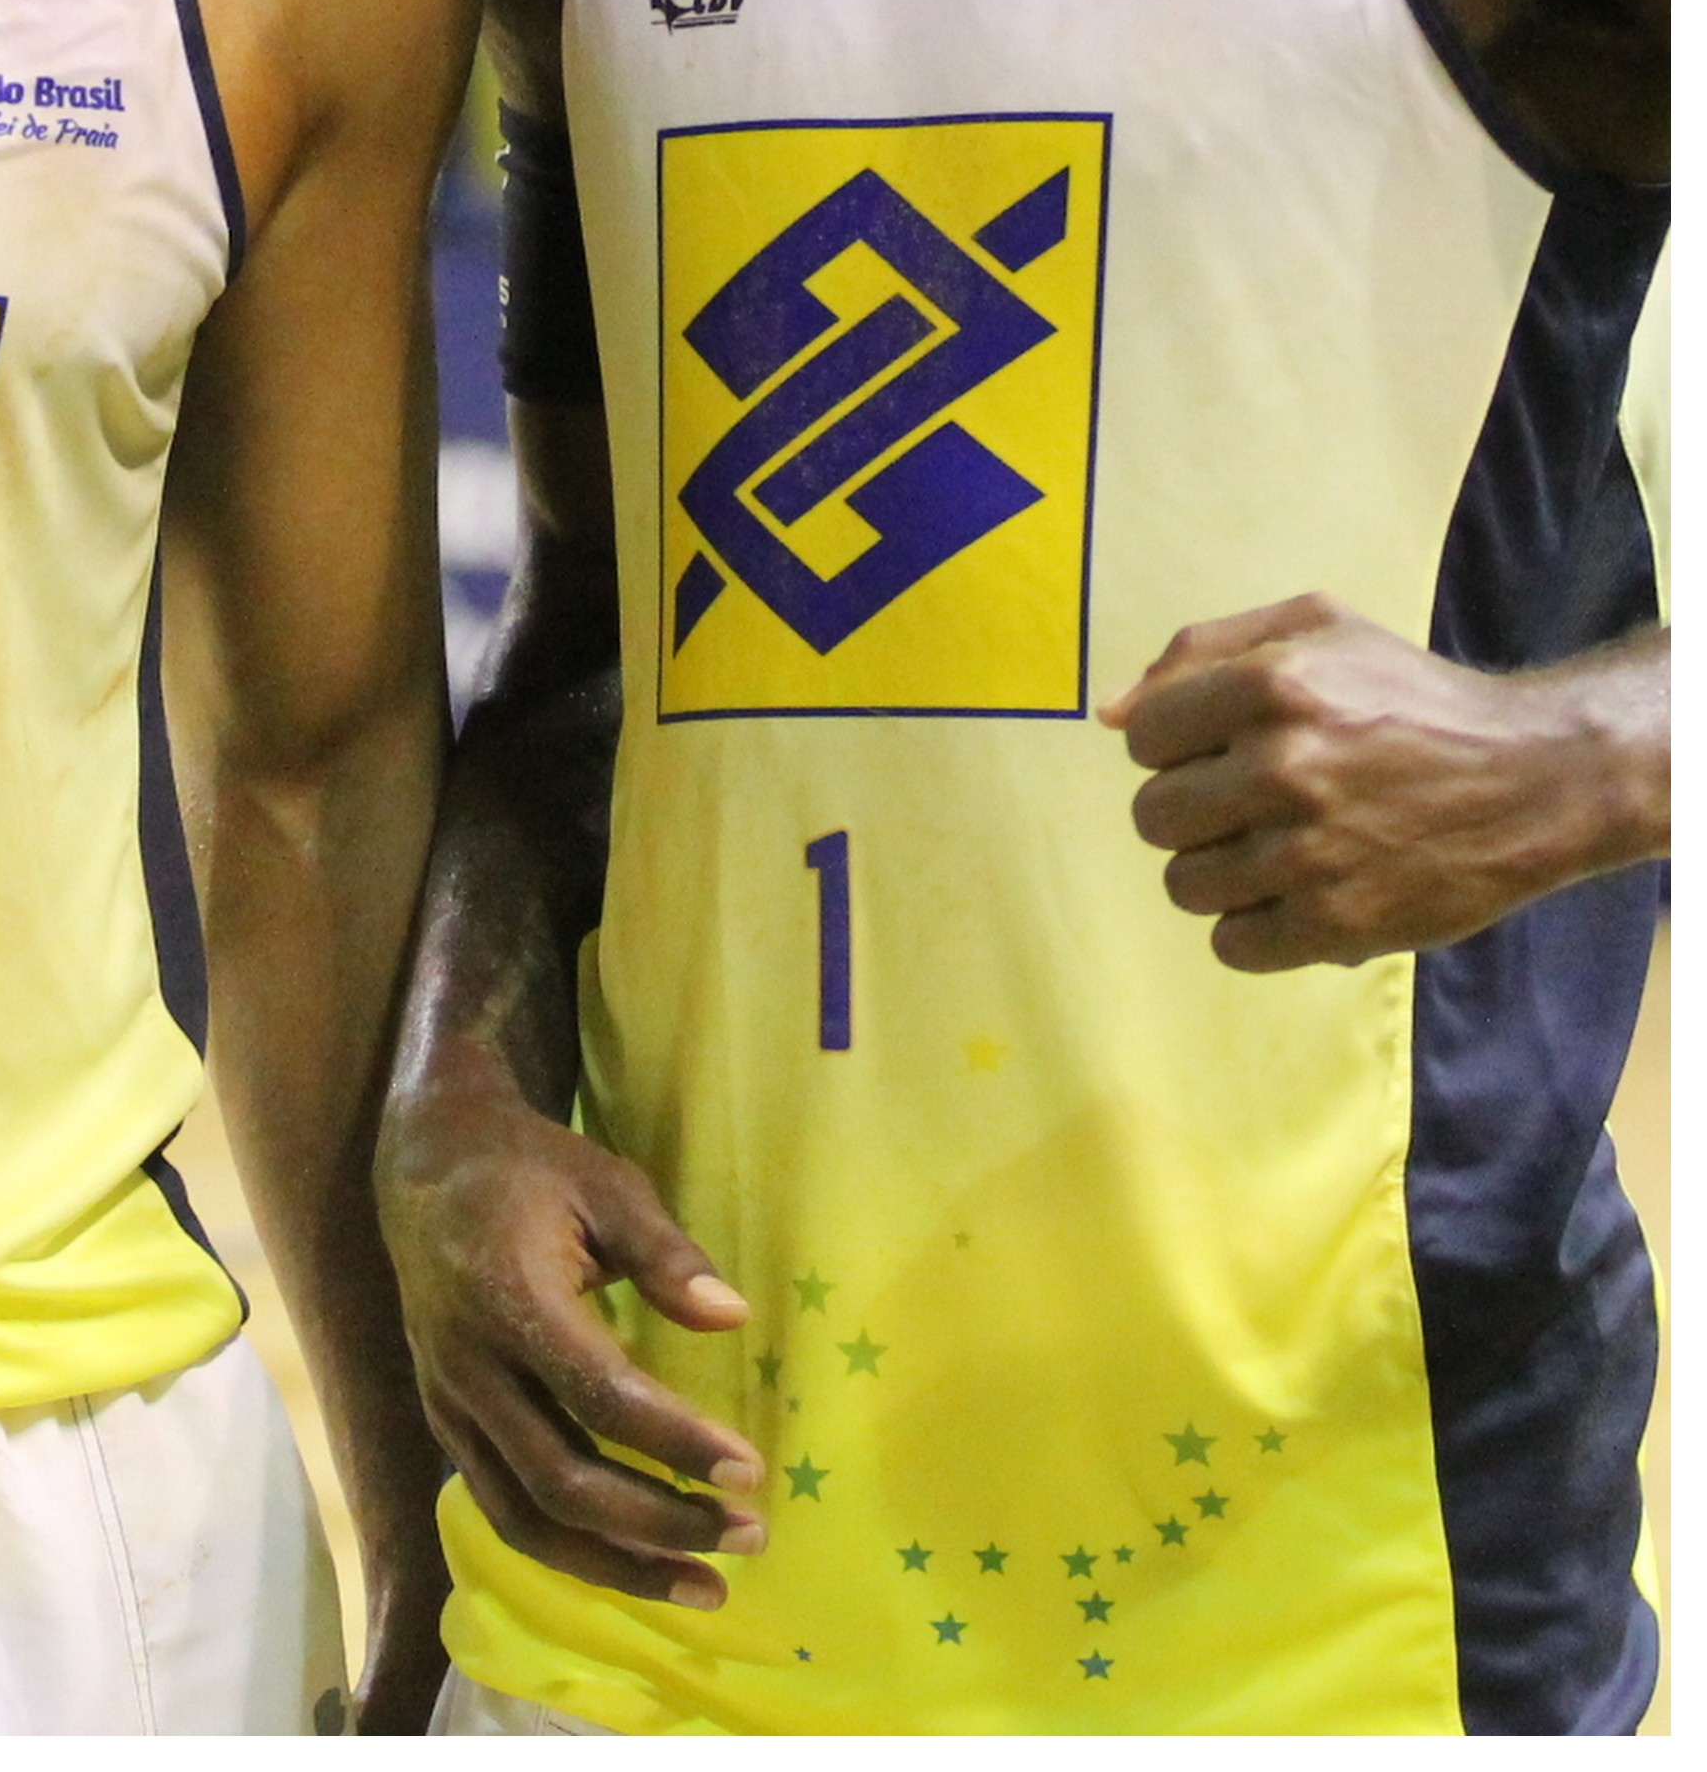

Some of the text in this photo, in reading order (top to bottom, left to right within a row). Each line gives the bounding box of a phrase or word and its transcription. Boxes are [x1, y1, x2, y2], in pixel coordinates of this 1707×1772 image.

[34, 77, 125, 111] Brasil
[22, 113, 48, 141] de
[55, 118, 119, 149] Praia
[805, 829, 851, 1052] 1
